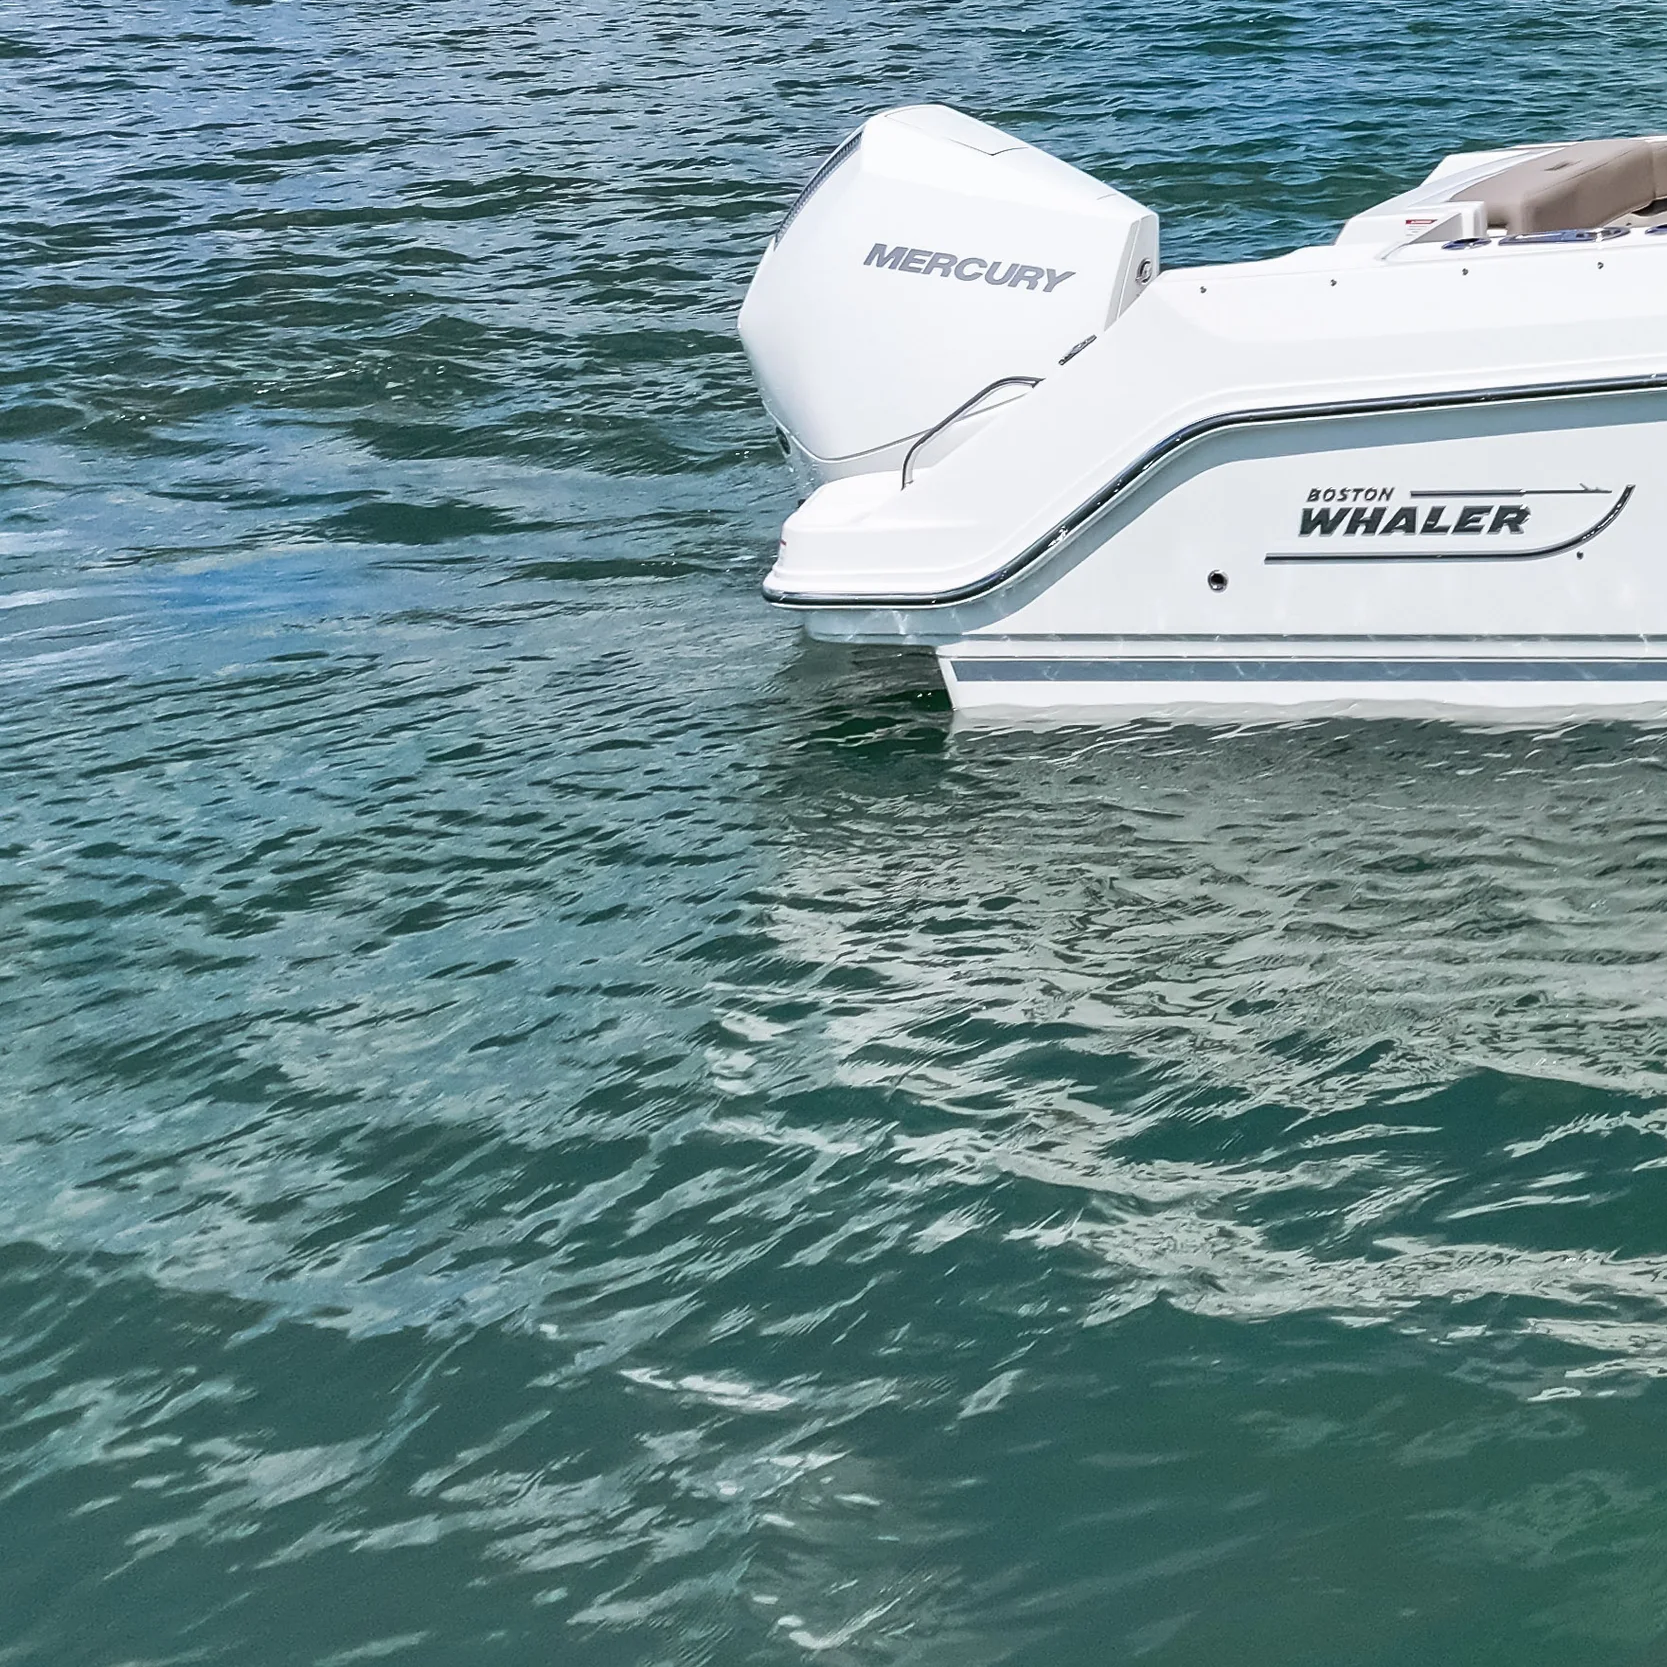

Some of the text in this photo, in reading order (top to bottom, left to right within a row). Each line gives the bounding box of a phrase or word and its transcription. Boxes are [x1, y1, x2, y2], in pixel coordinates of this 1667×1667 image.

[864, 243, 1077, 293] MERCURY
[1306, 487, 1395, 503] BOSTON
[1298, 504, 1532, 537] WHALER
